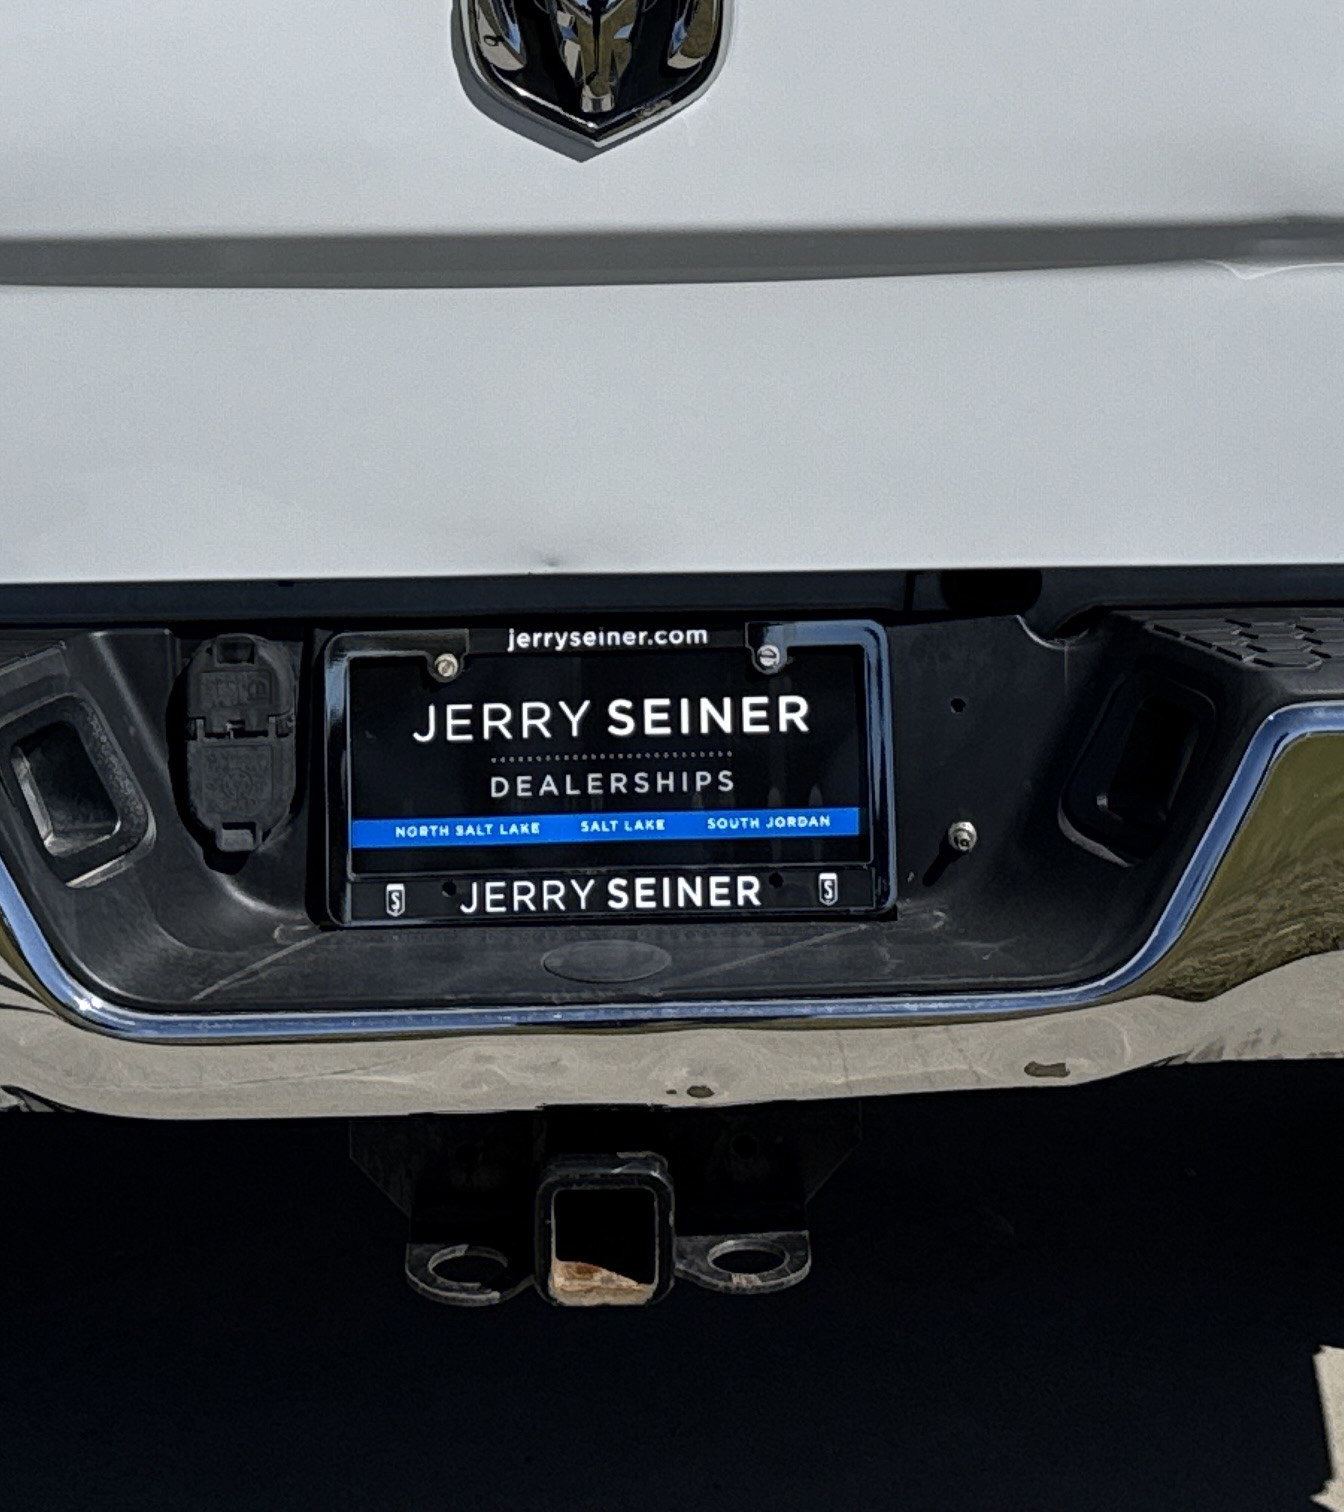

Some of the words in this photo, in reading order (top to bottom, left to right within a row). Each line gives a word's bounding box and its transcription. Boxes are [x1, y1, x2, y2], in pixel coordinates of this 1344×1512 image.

[507, 626, 709, 652] jerryseiner.com
[412, 700, 591, 744] JERRY
[606, 694, 810, 738] SEINER
[490, 770, 735, 799] DEALERSHIPS
[395, 825, 450, 838] NORTH
[455, 823, 494, 837] SALT
[499, 821, 540, 836] LAKE
[580, 820, 619, 833] SALT
[624, 818, 666, 832] LAKE
[707, 816, 760, 830] SOUTH
[765, 814, 831, 829] JORDAN
[459, 878, 596, 915] JERRY
[607, 874, 762, 910] SEINER
